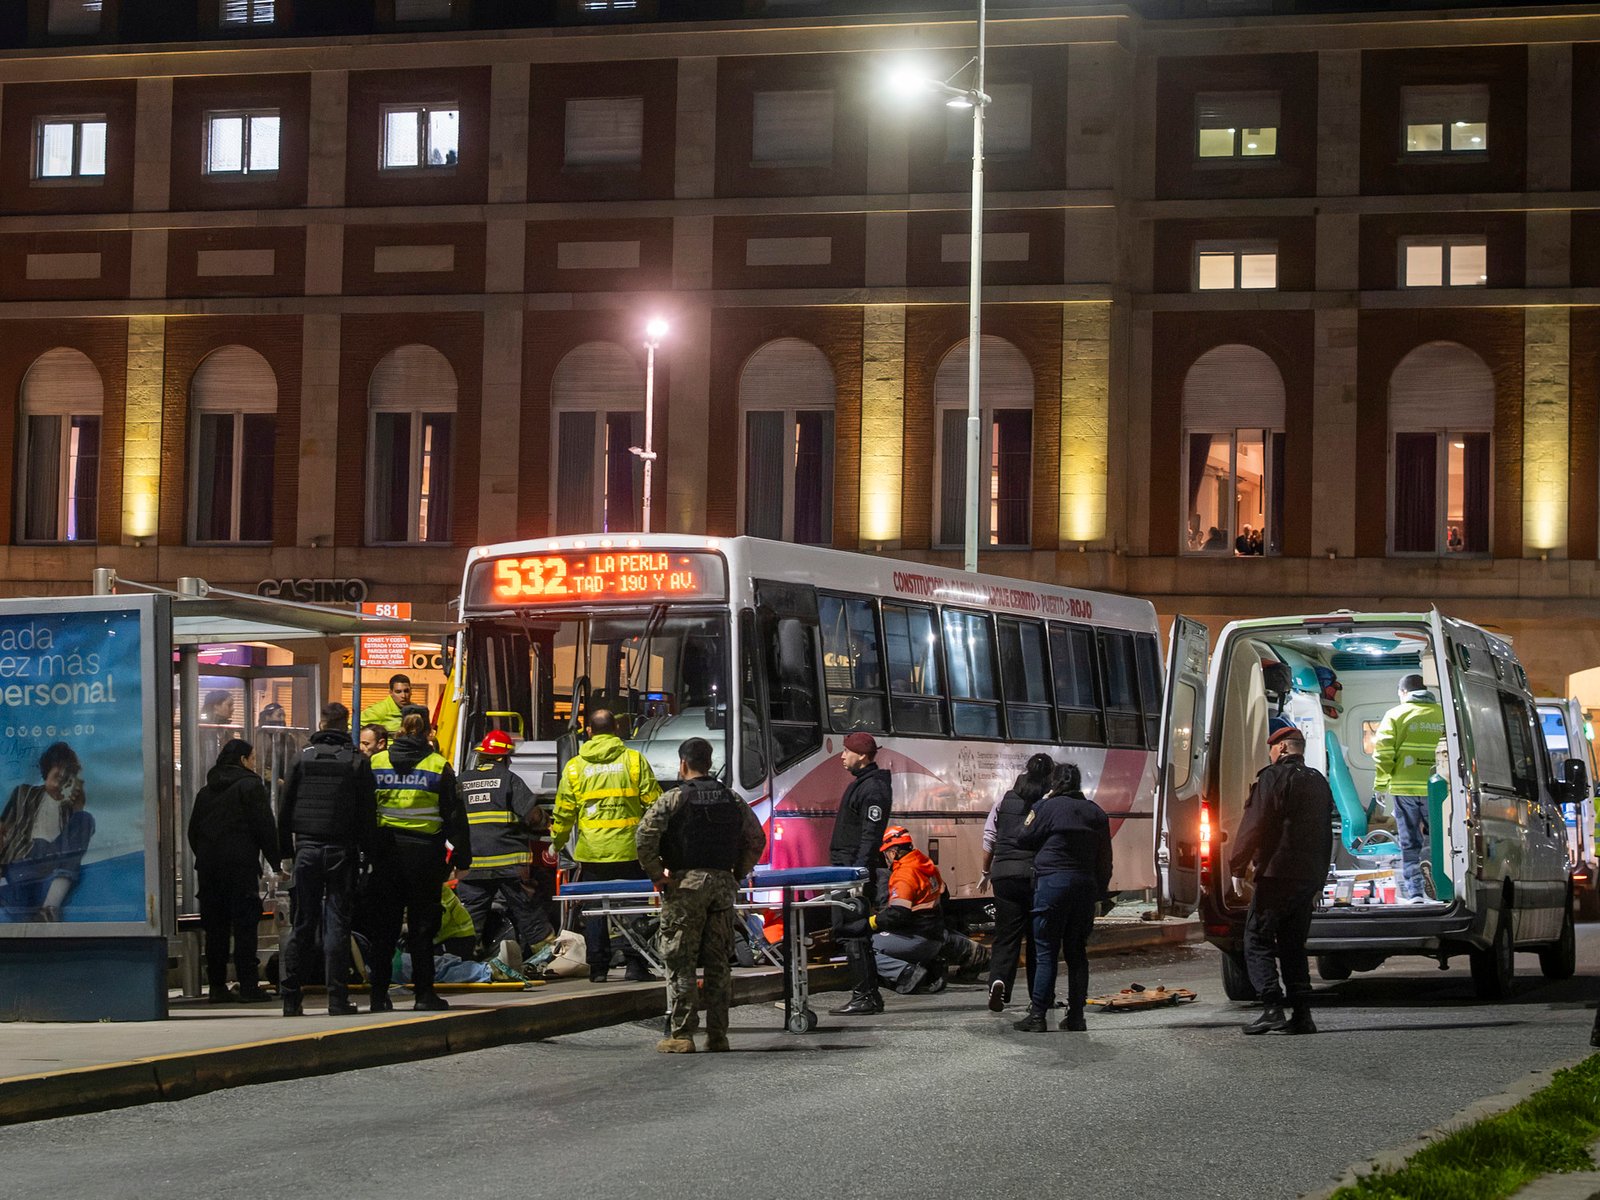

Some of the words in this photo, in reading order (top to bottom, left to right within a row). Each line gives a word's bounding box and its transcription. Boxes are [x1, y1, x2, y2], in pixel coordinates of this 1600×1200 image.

[595, 556, 615, 573] LA
[620, 554, 668, 572] PERLA
[498, 558, 567, 596] 532
[620, 574, 648, 592] 190
[653, 573, 665, 590] Y
[670, 572, 696, 590] AV.
[375, 604, 399, 617] 581
[1069, 599, 1092, 619] ROJO
[1, 621, 55, 650] ada
[0, 656, 30, 678] ez
[38, 647, 101, 677] más
[0, 674, 117, 707] ersonal
[462, 780, 499, 790] BOMBEROS
[469, 794, 490, 804] P.B.A.
